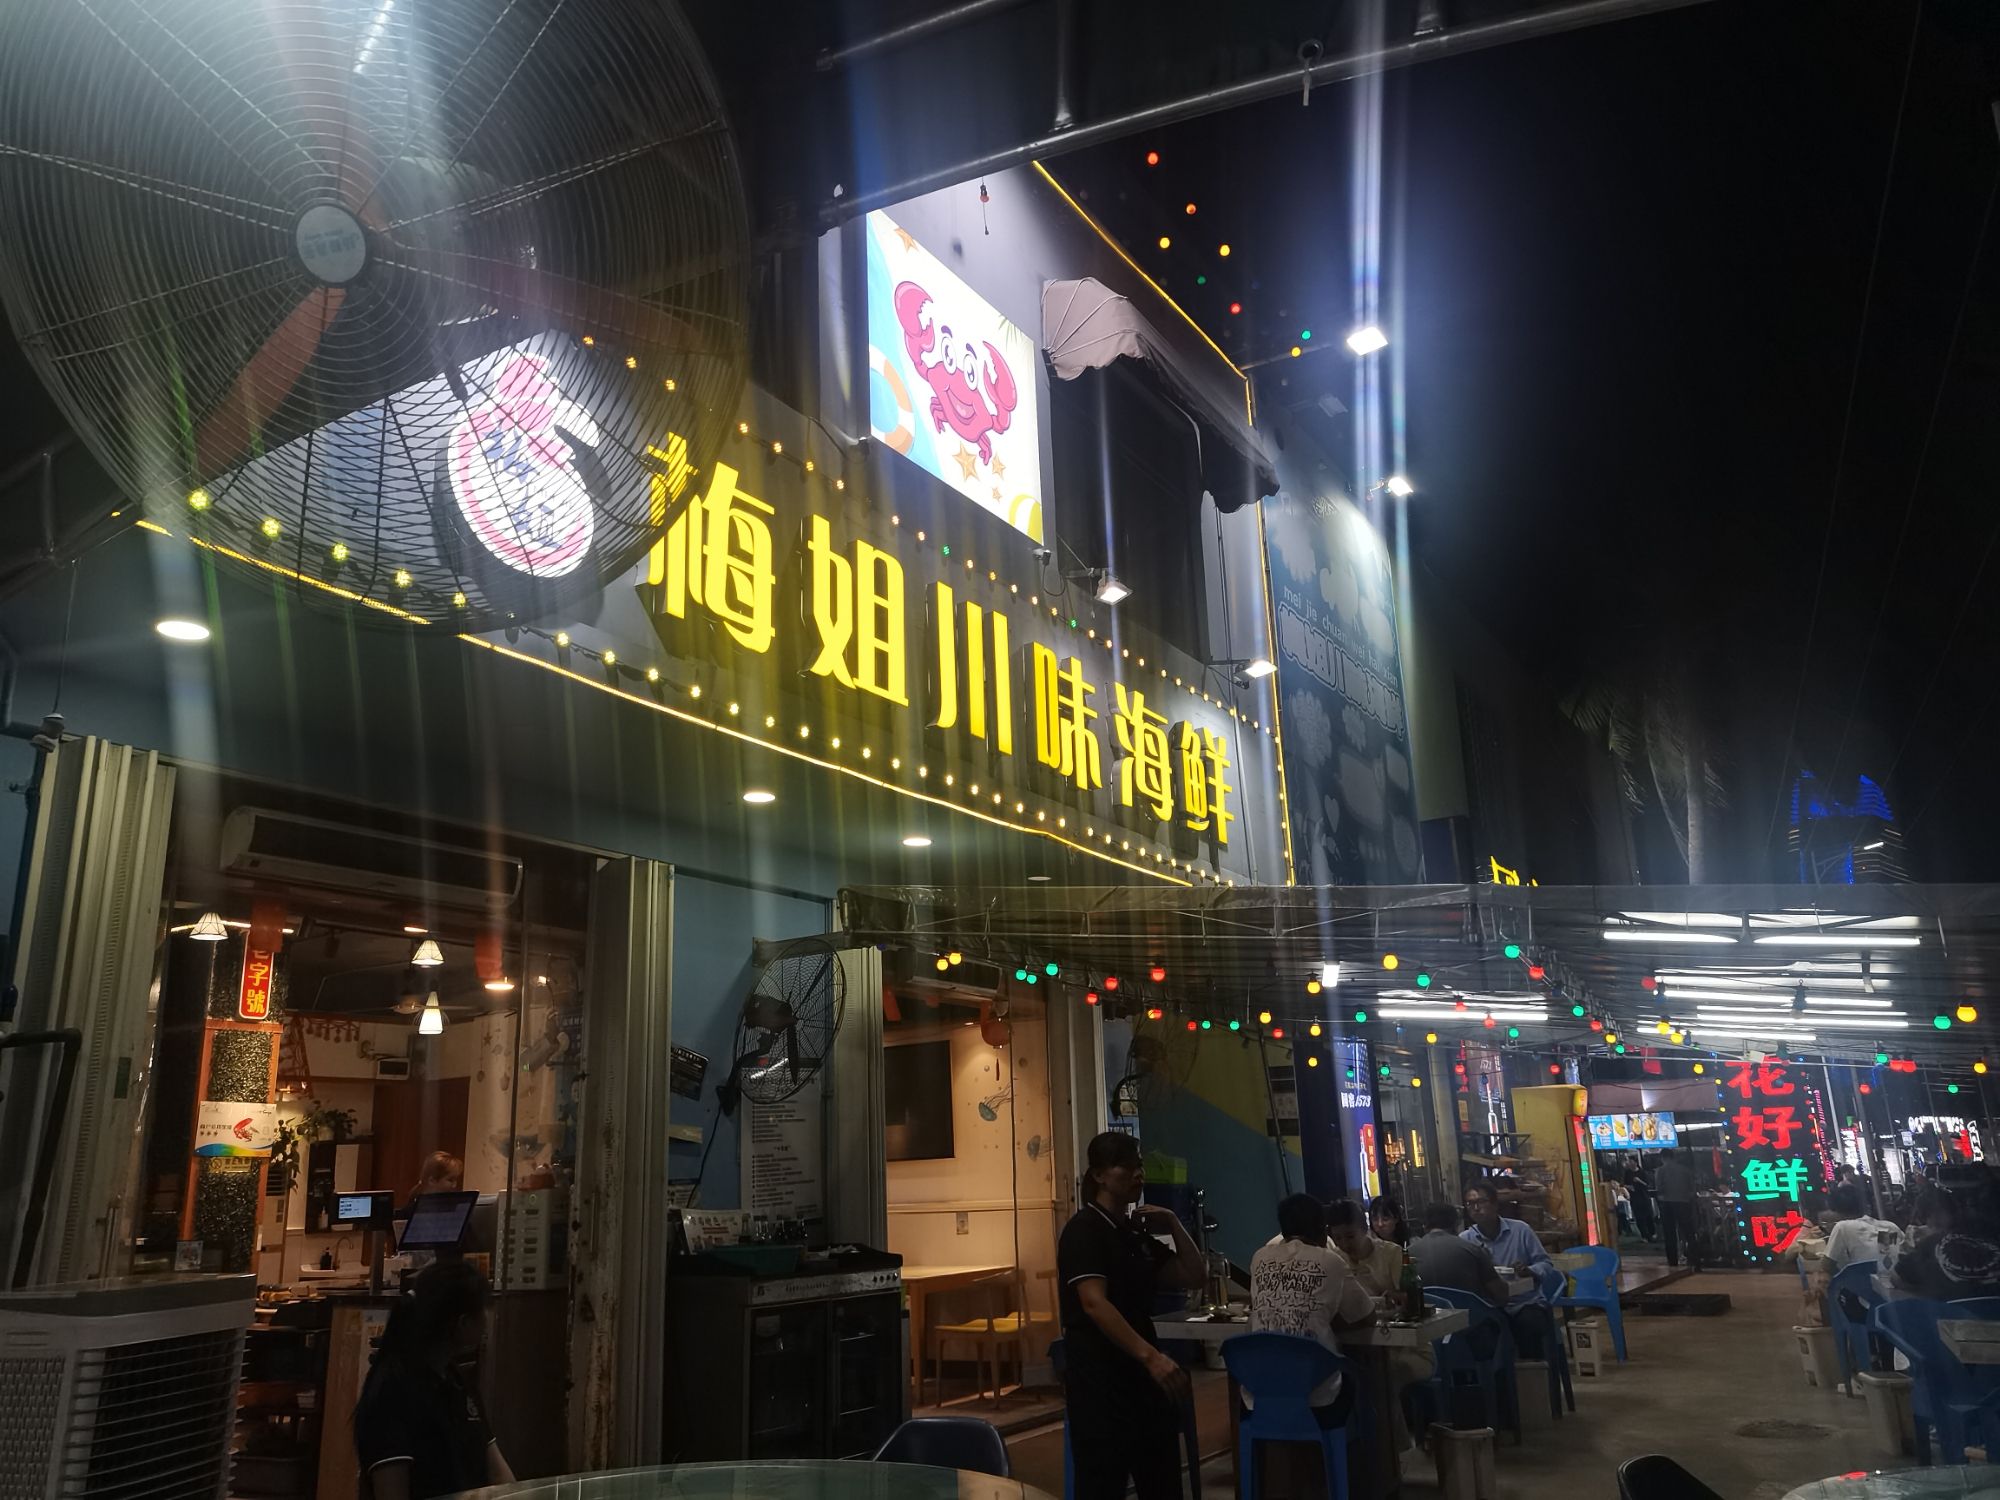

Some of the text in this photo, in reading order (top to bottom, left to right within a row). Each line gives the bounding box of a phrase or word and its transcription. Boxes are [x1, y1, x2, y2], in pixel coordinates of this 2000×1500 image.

[646, 432, 1234, 843] 梅姐川味海鲜
[1283, 586, 1302, 610] mei
[1306, 599, 1318, 621] jie
[1322, 615, 1347, 643] chuan
